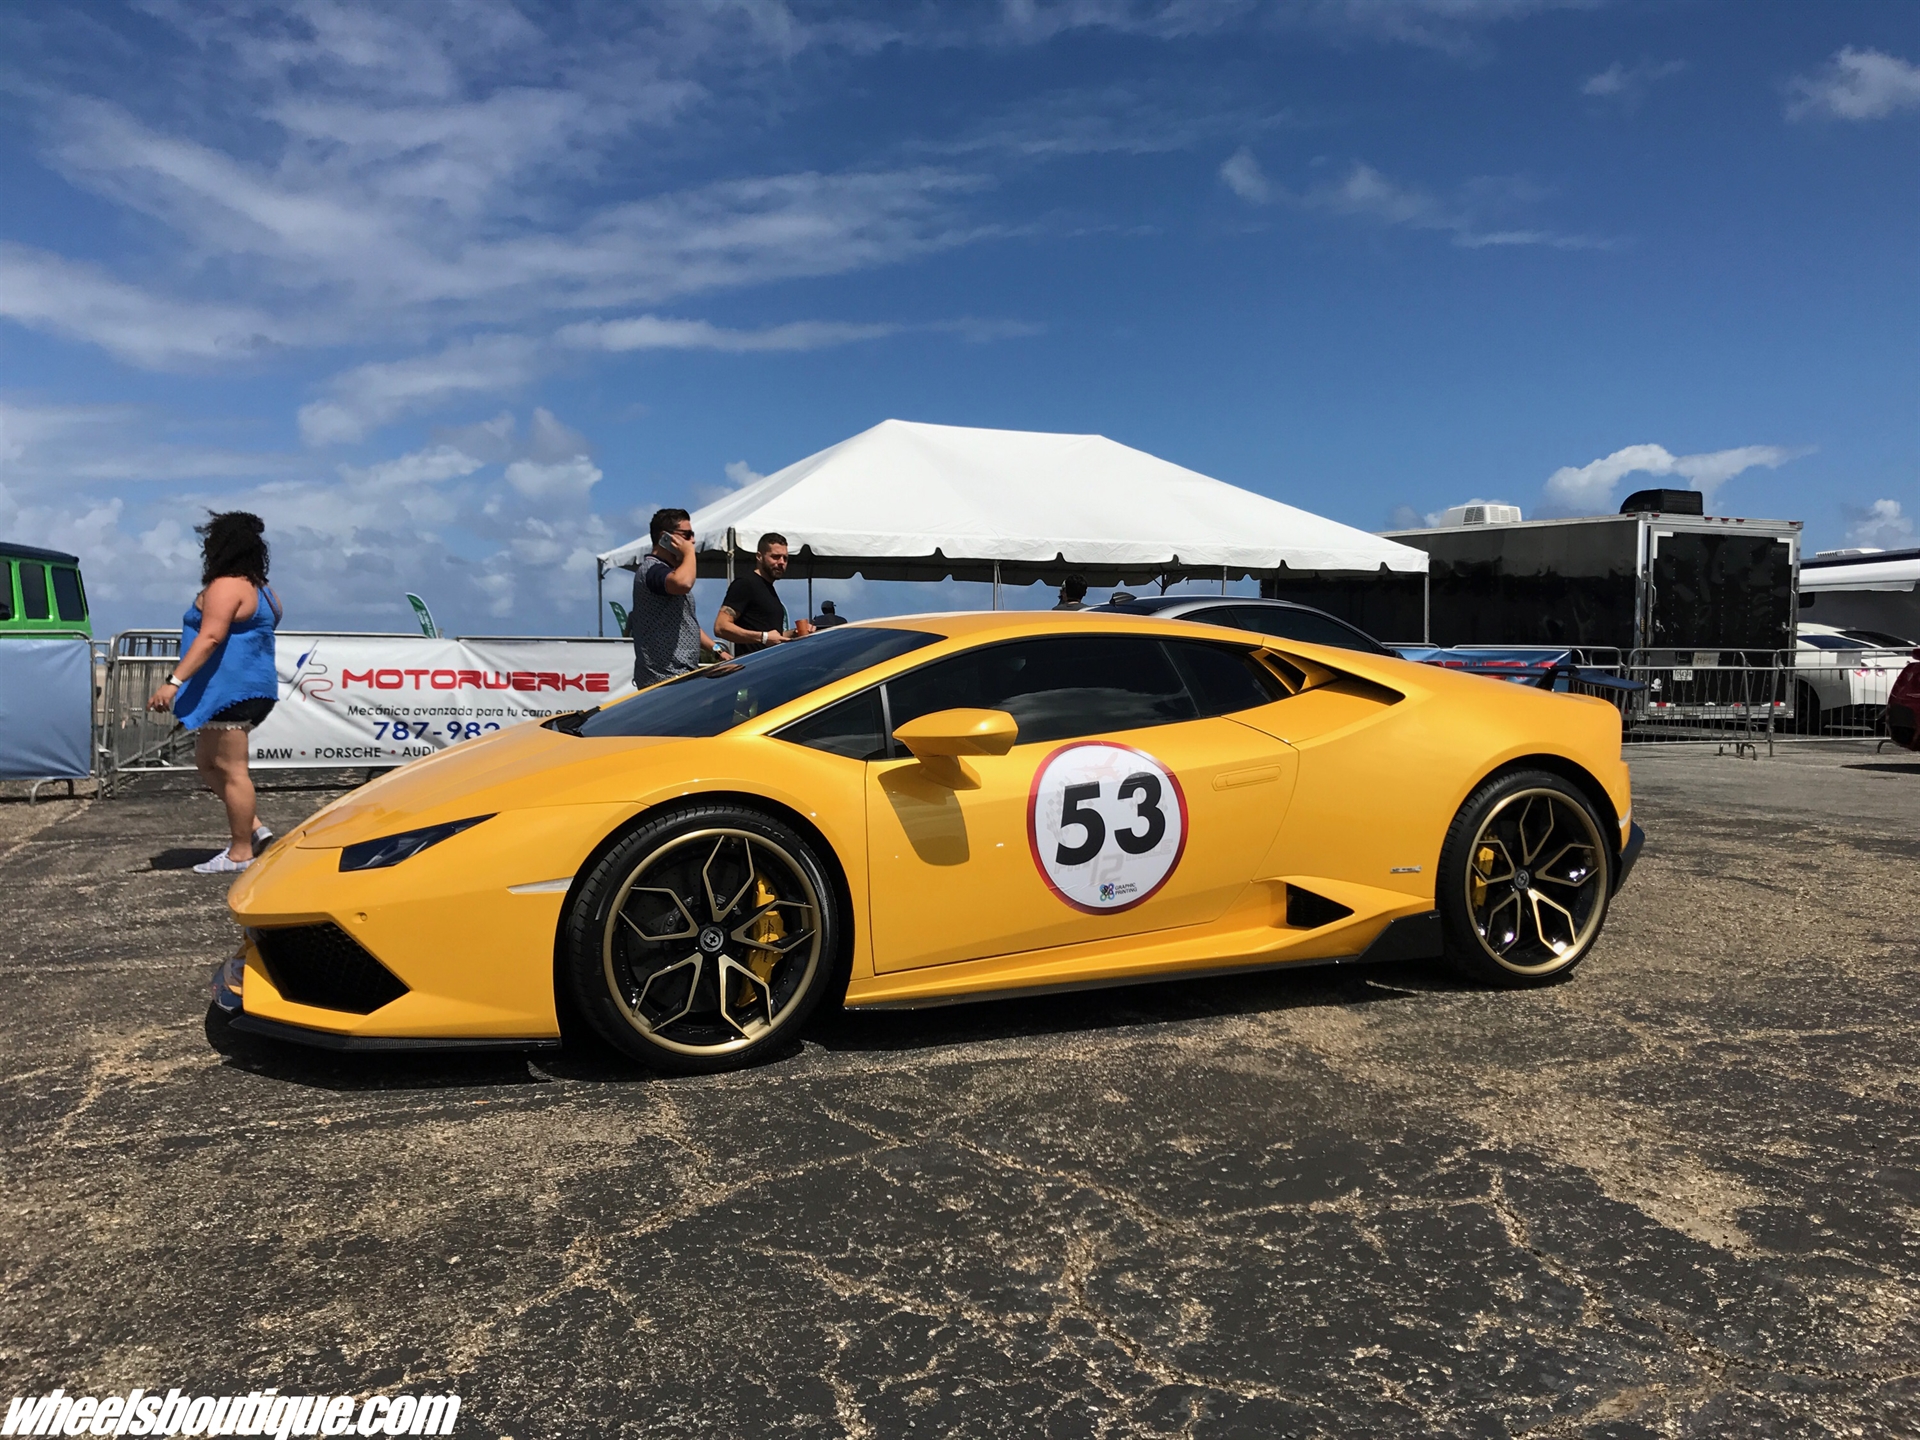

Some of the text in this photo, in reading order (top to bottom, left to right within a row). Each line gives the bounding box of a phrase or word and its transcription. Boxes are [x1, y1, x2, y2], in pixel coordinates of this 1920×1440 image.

[342, 669, 610, 692] MOTORWERKE
[347, 705, 410, 716] Mecánica
[413, 705, 473, 717] avanzada
[476, 707, 504, 719] para
[507, 706, 518, 718] tu
[521, 708, 552, 718] carro
[256, 746, 435, 759] BMW PORSCHE AUDI
[1055, 771, 1166, 866] 53
[1114, 887, 1138, 895] PRINTING
